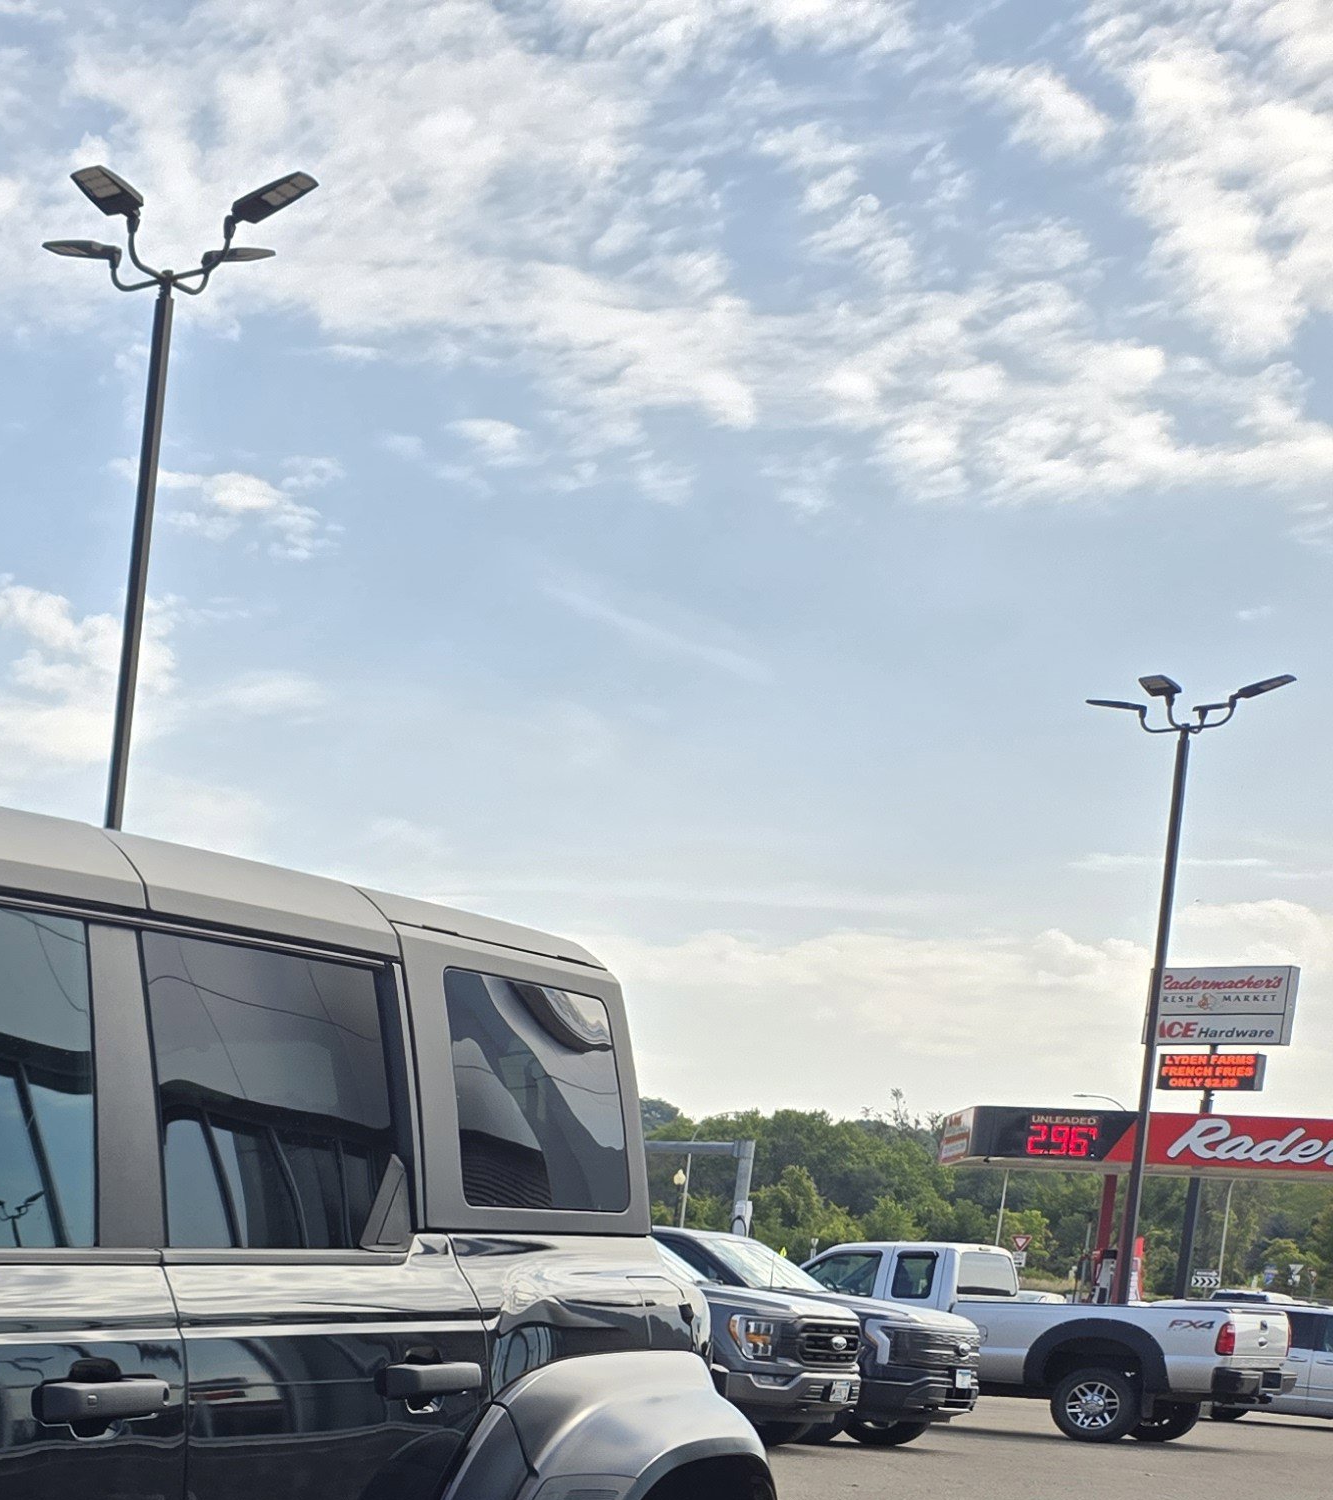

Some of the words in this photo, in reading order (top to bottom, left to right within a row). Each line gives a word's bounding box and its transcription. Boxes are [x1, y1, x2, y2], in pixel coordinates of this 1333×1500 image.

[1162, 994, 1194, 1003] RESH
[1222, 994, 1278, 1002] MARKET
[1197, 1027, 1275, 1039] Hardware
[1165, 1055, 1208, 1065] LYDEN
[1210, 1055, 1255, 1065] FARMS
[1161, 1066, 1213, 1076] FRENCH
[1215, 1066, 1254, 1077] FRIES
[1169, 1078, 1203, 1087] ONLY
[1031, 1115, 1097, 1125] UNLEADED
[1168, 1319, 1215, 1330] FX4
